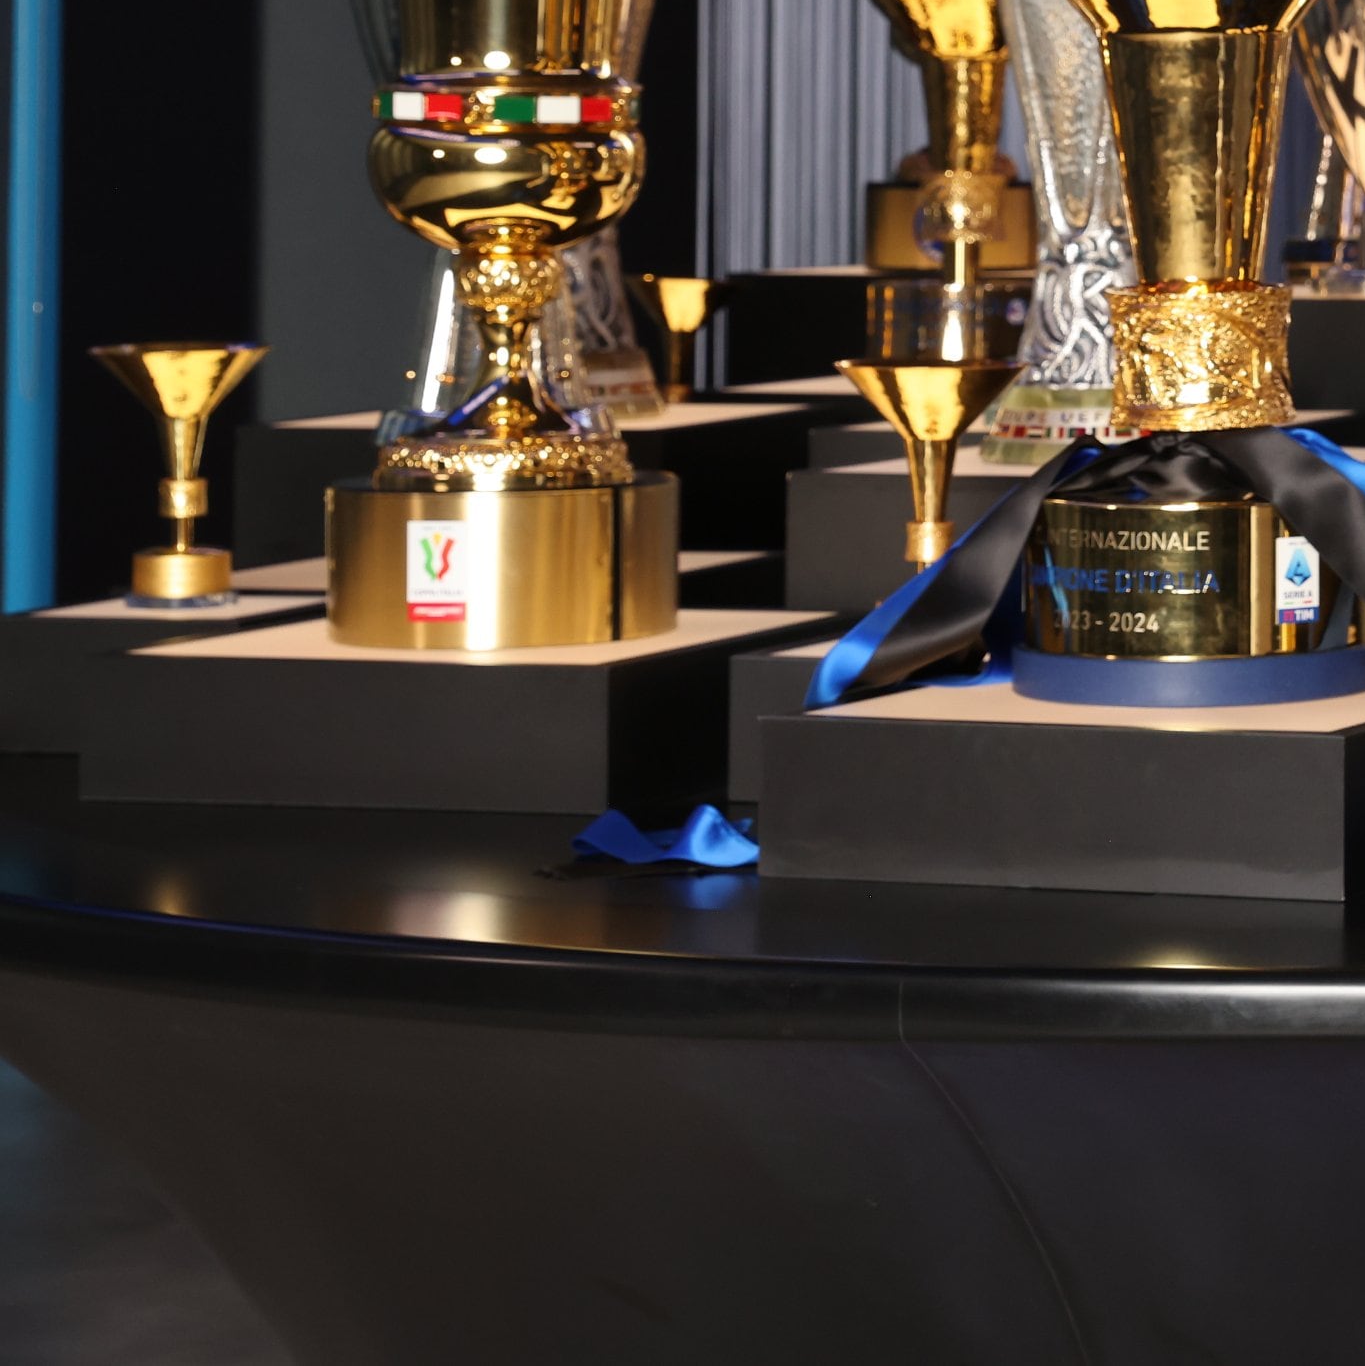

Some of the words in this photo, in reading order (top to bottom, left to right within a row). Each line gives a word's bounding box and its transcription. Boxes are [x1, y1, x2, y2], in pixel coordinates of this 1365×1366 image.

[1059, 412, 1106, 424] UEF
[1114, 568, 1221, 595] D'ITALIA
[1053, 610, 1092, 631] 223
[1108, 612, 1160, 634] 2024
